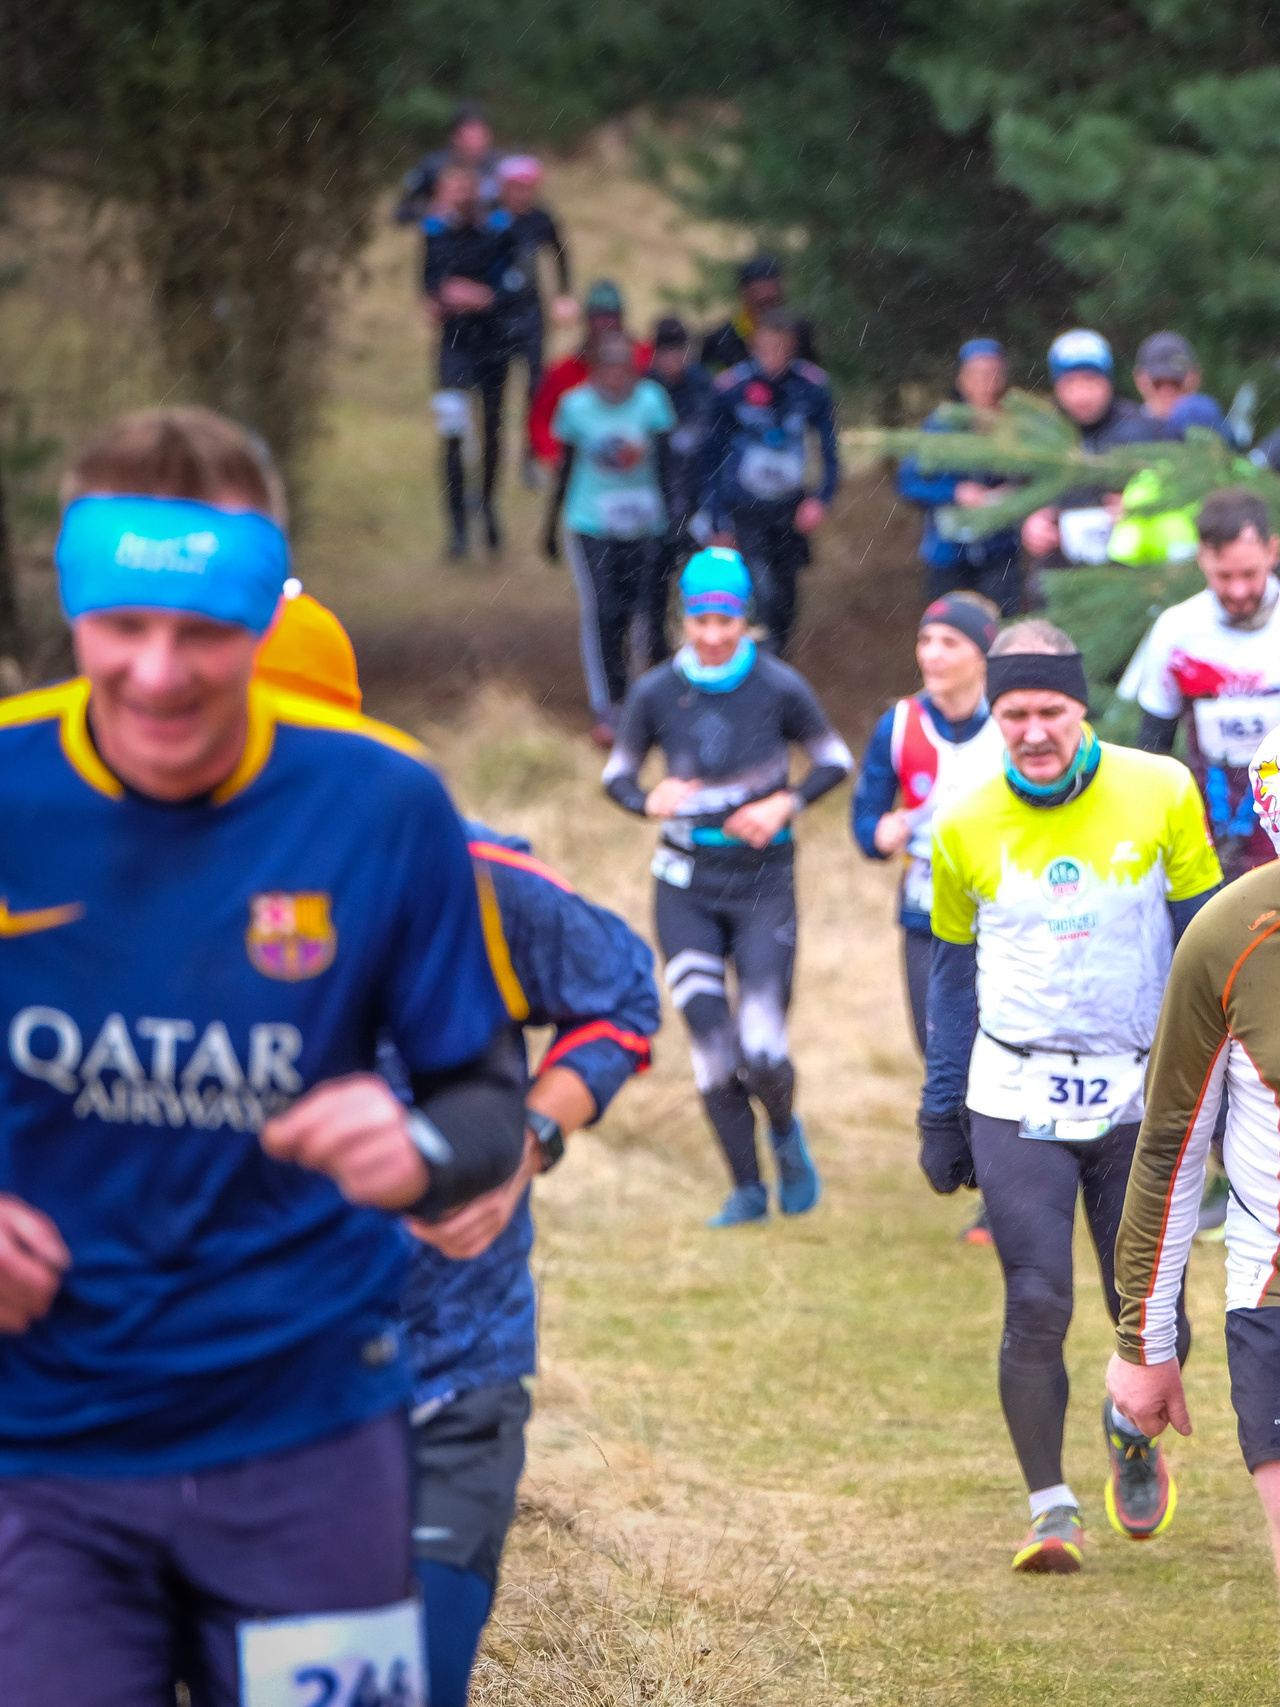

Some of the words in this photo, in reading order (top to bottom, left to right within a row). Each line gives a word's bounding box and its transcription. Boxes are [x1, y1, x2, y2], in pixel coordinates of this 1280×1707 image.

[8, 1005, 304, 1094] QATAR
[73, 1078, 290, 1133] AIRWAY
[1049, 1076, 1108, 1106] 312
